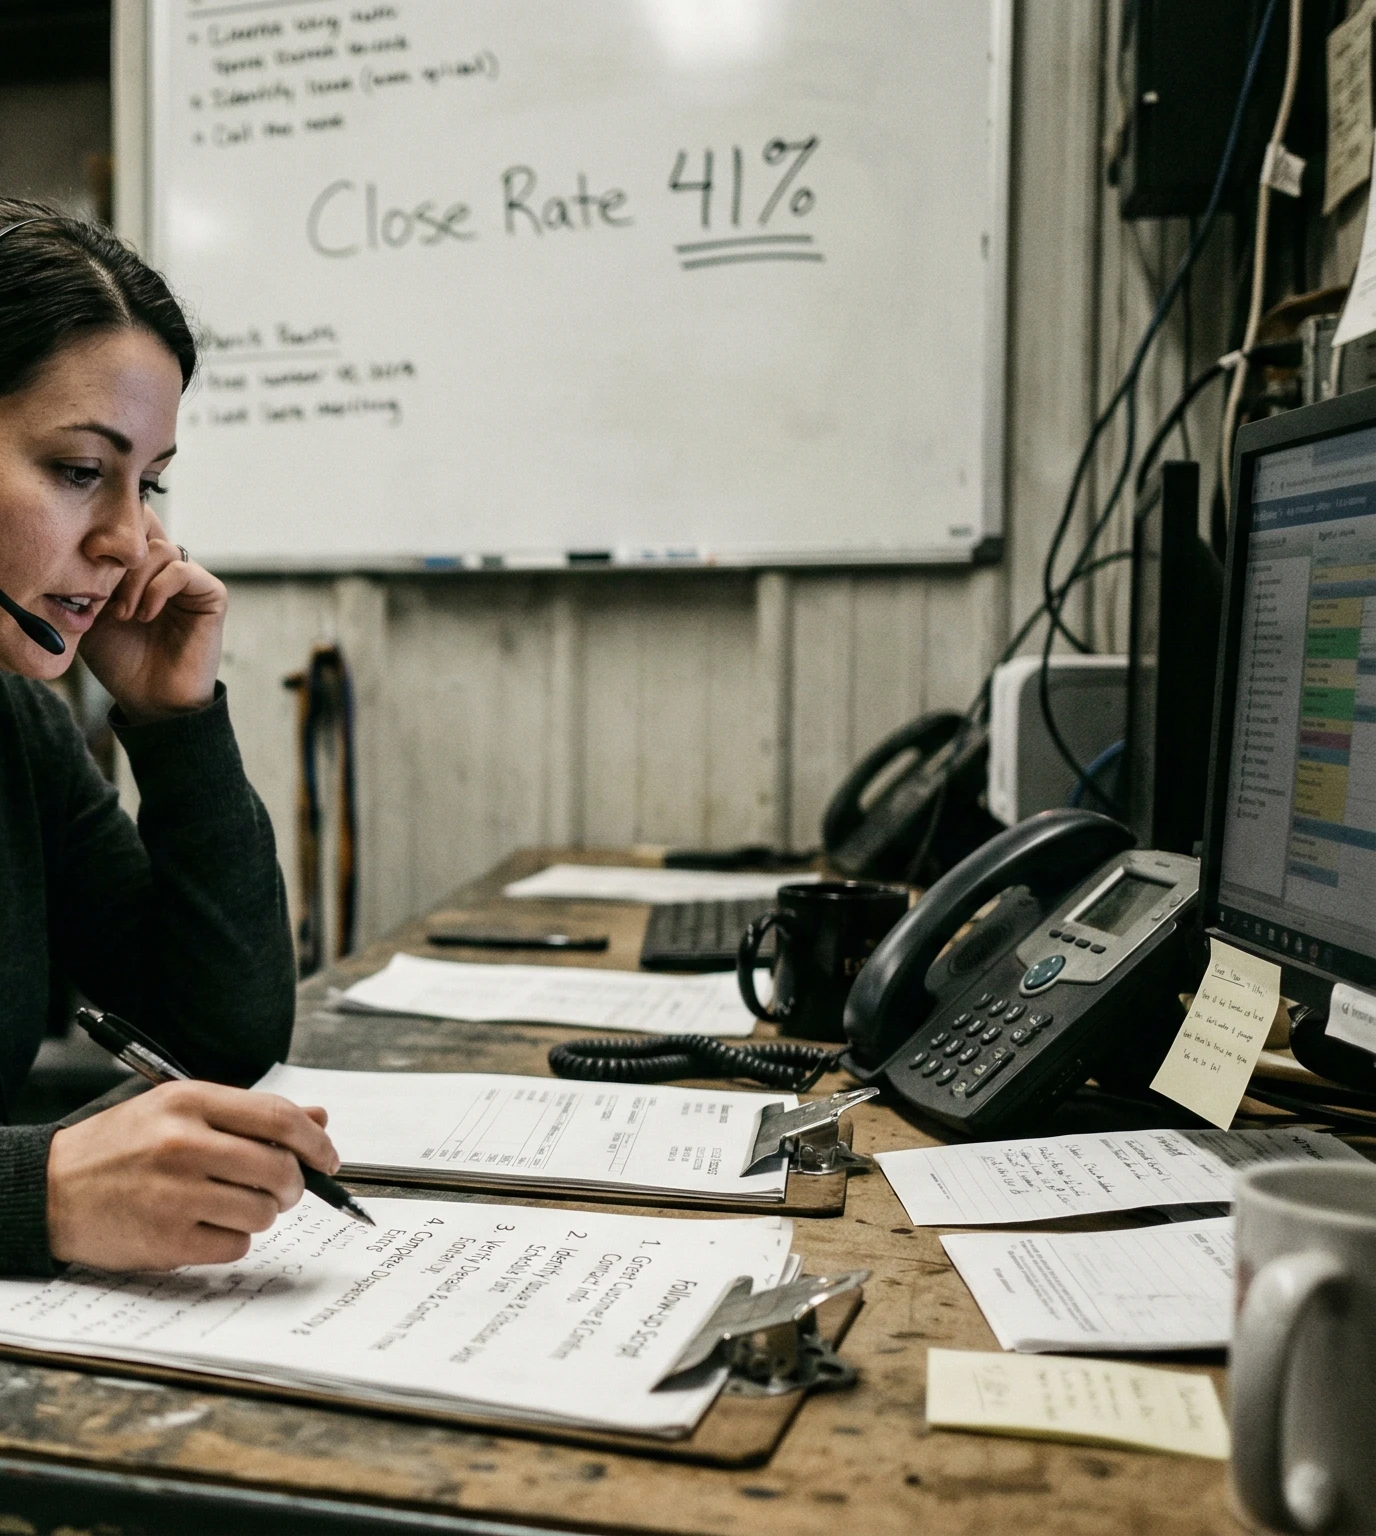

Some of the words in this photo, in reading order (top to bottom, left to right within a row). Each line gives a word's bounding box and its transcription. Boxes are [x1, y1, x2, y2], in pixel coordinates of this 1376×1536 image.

[306, 179, 478, 259] Close
[501, 164, 634, 236] Rate
[669, 135, 820, 229] 41%
[423, 1217, 444, 1227] 4.
[493, 1223, 516, 1233] 3.
[565, 1230, 588, 1240] 2.
[639, 1240, 661, 1248] 1.
